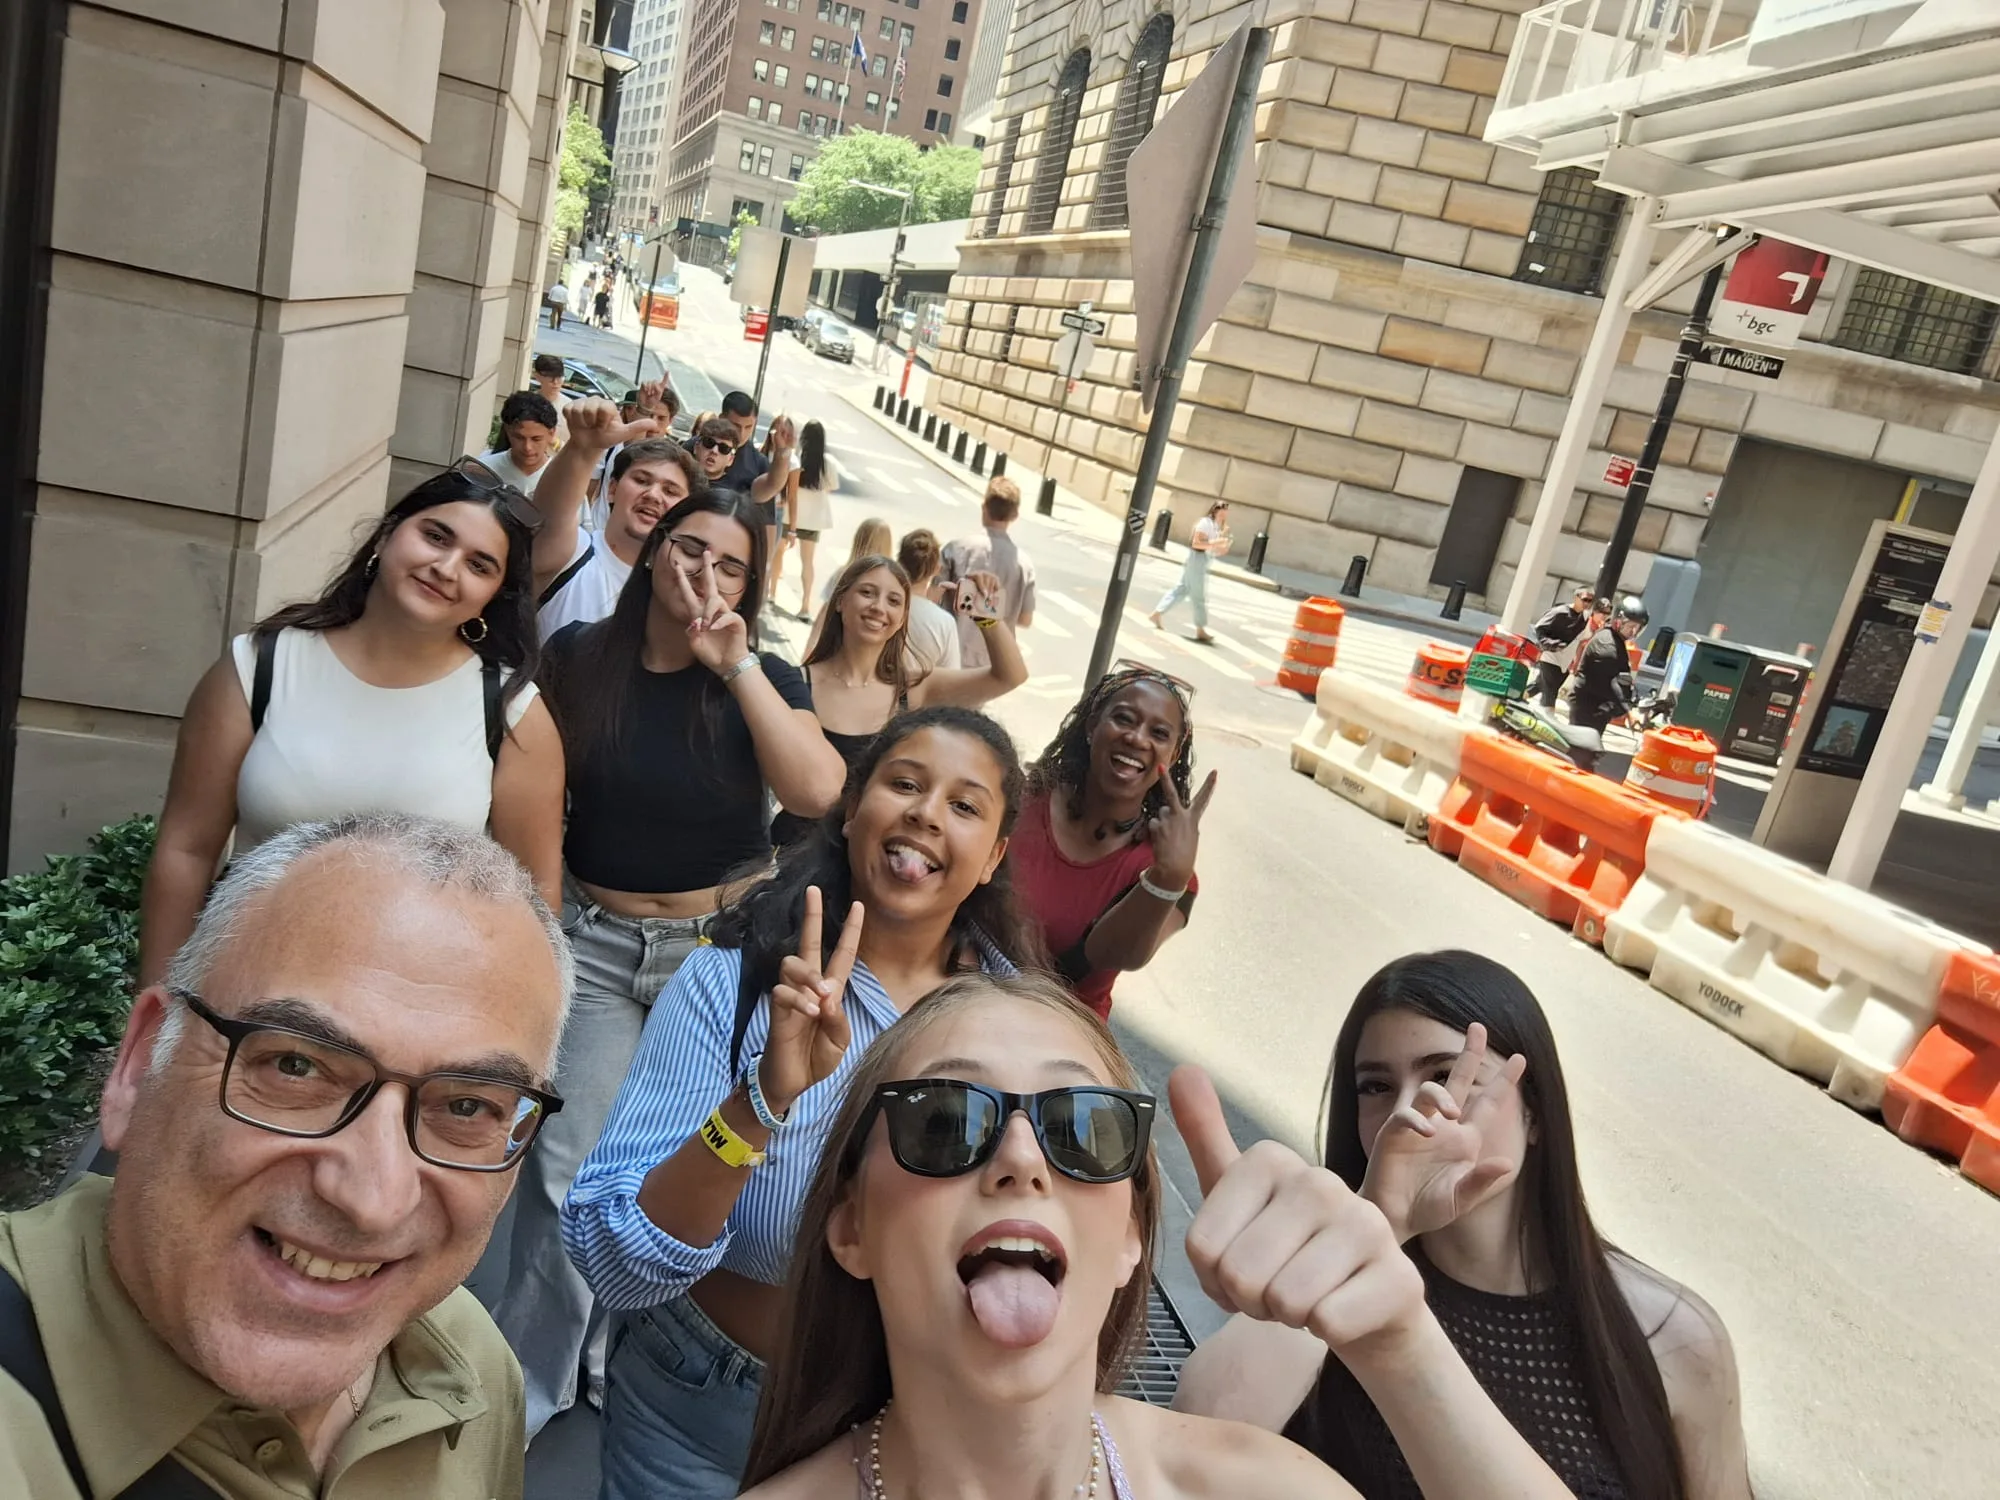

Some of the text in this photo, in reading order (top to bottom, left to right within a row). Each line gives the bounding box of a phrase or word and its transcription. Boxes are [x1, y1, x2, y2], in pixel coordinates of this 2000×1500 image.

[1747, 316, 1777, 334] bgc
[1723, 353, 1768, 373] MAIDEN
[1699, 981, 1744, 1018] YODOCK
